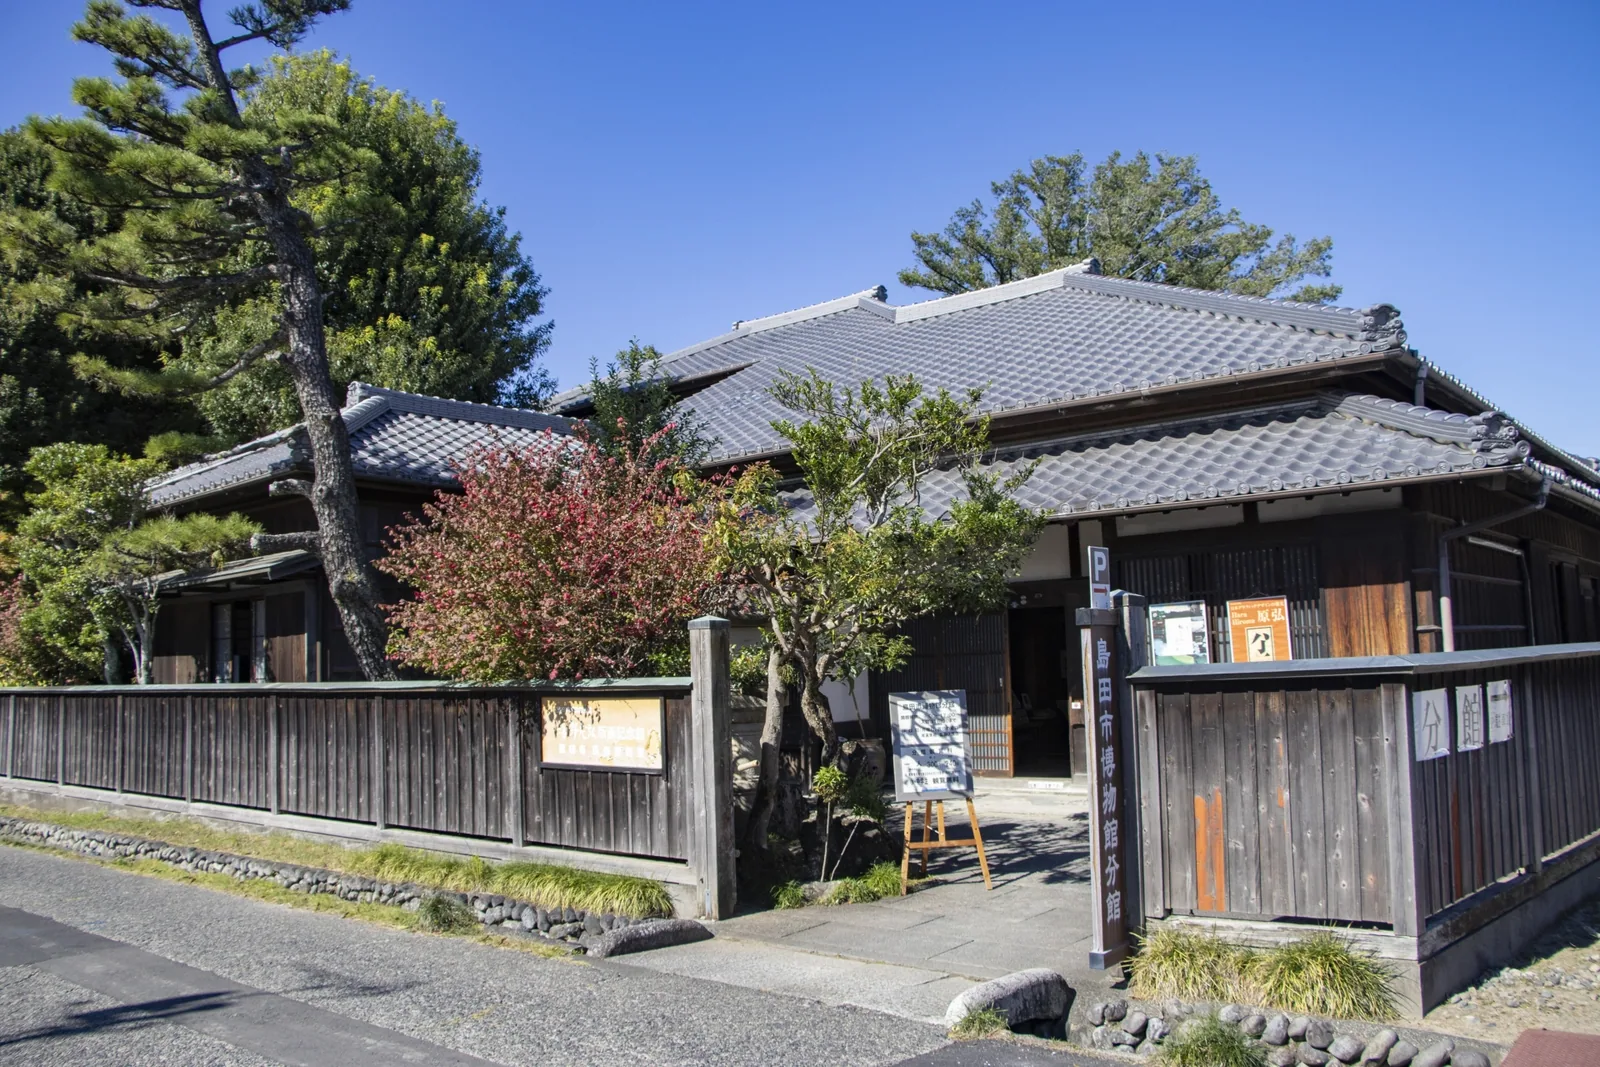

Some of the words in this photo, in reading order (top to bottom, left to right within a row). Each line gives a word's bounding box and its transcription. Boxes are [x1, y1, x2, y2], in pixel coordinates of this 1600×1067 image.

[1093, 550, 1107, 582] P
[1422, 699, 1442, 757] 分
[1462, 692, 1480, 748] 館
[1096, 637, 1121, 924] 島田市博物館分館
